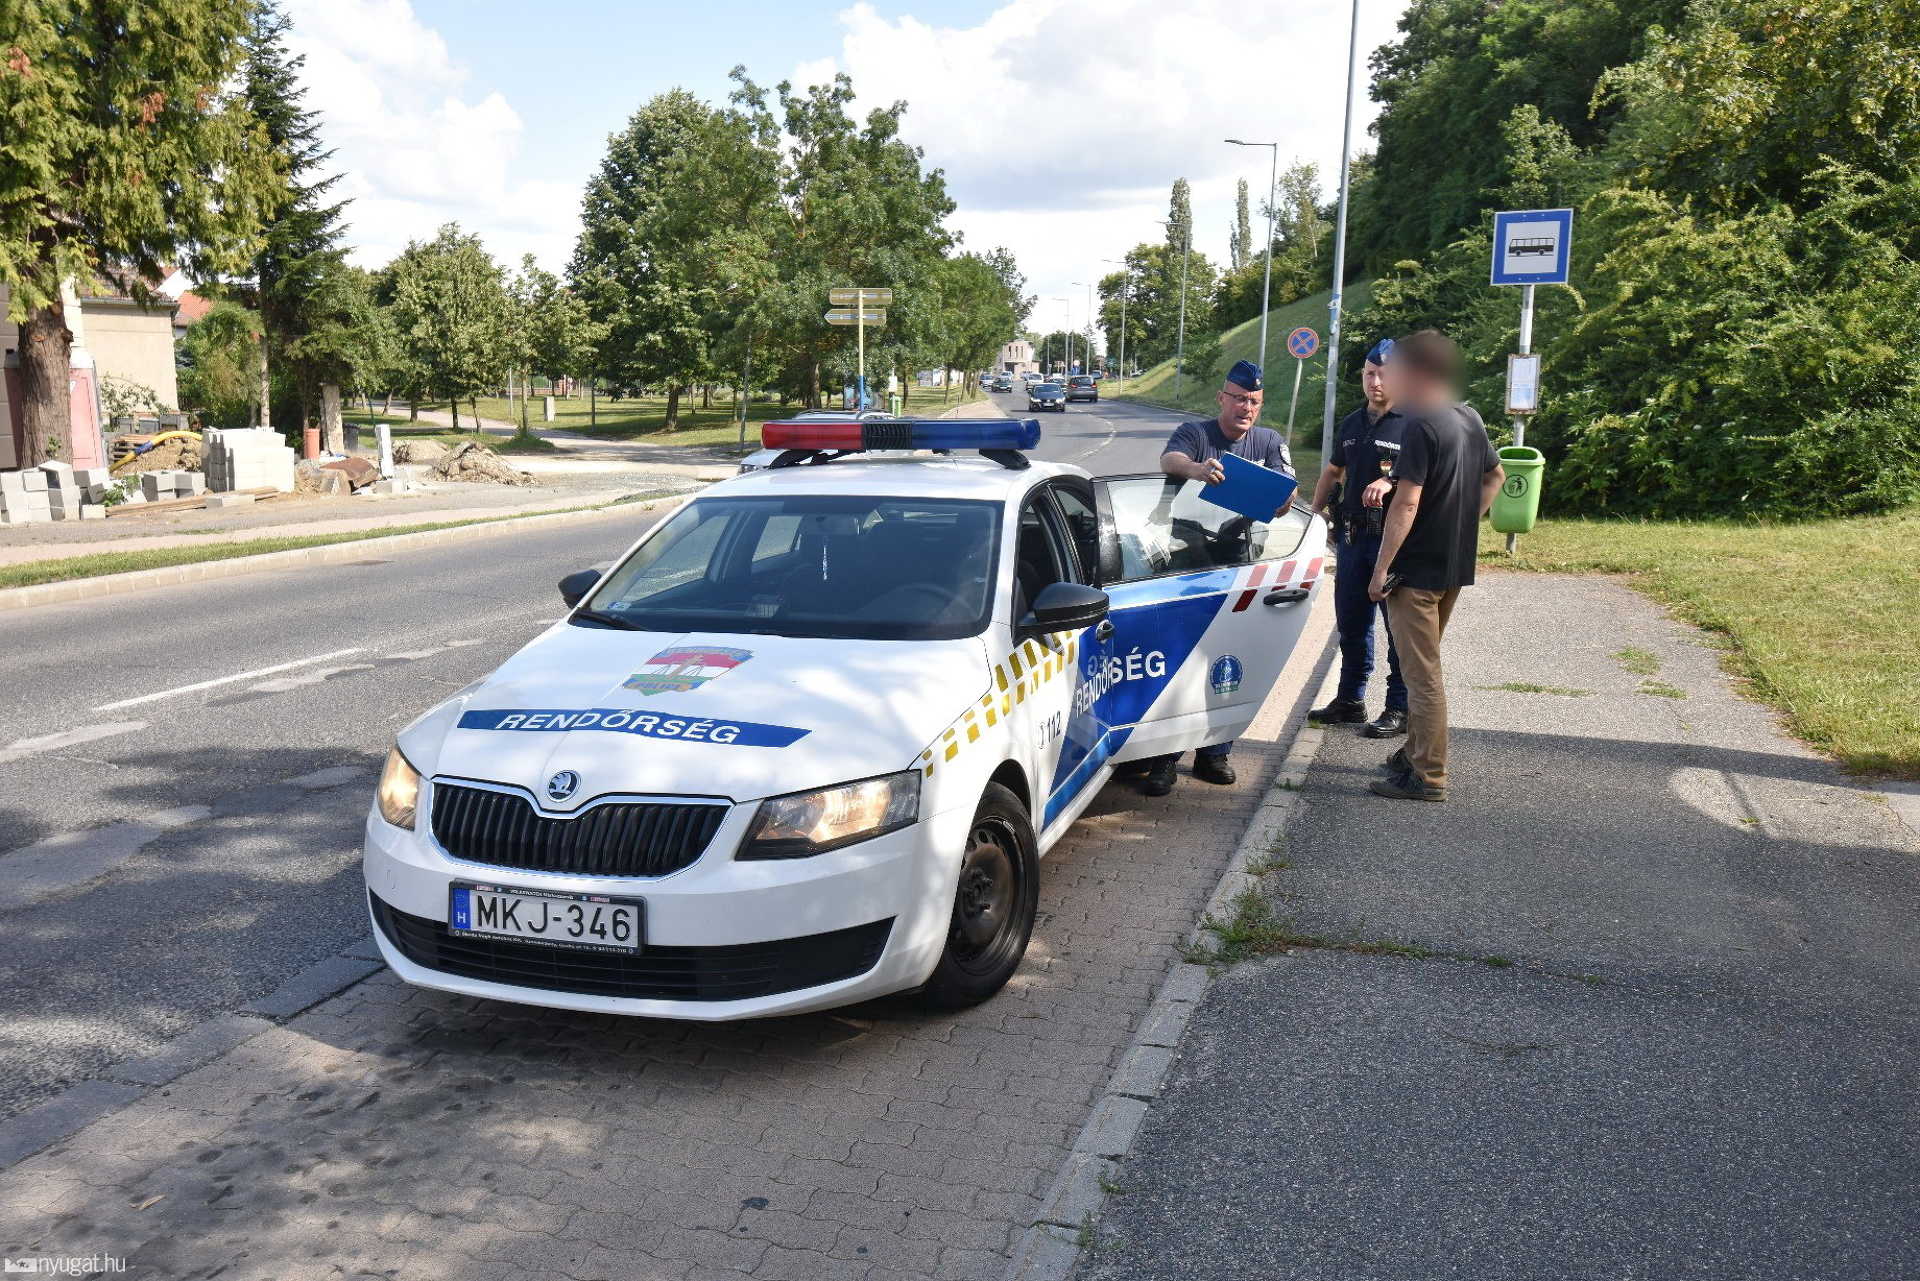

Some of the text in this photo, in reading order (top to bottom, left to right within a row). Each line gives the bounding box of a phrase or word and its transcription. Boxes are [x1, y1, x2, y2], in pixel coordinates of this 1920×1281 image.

[495, 709, 742, 744] RENDŐRSÉG
[457, 911, 467, 925] H
[477, 895, 631, 942] MKJ-346
